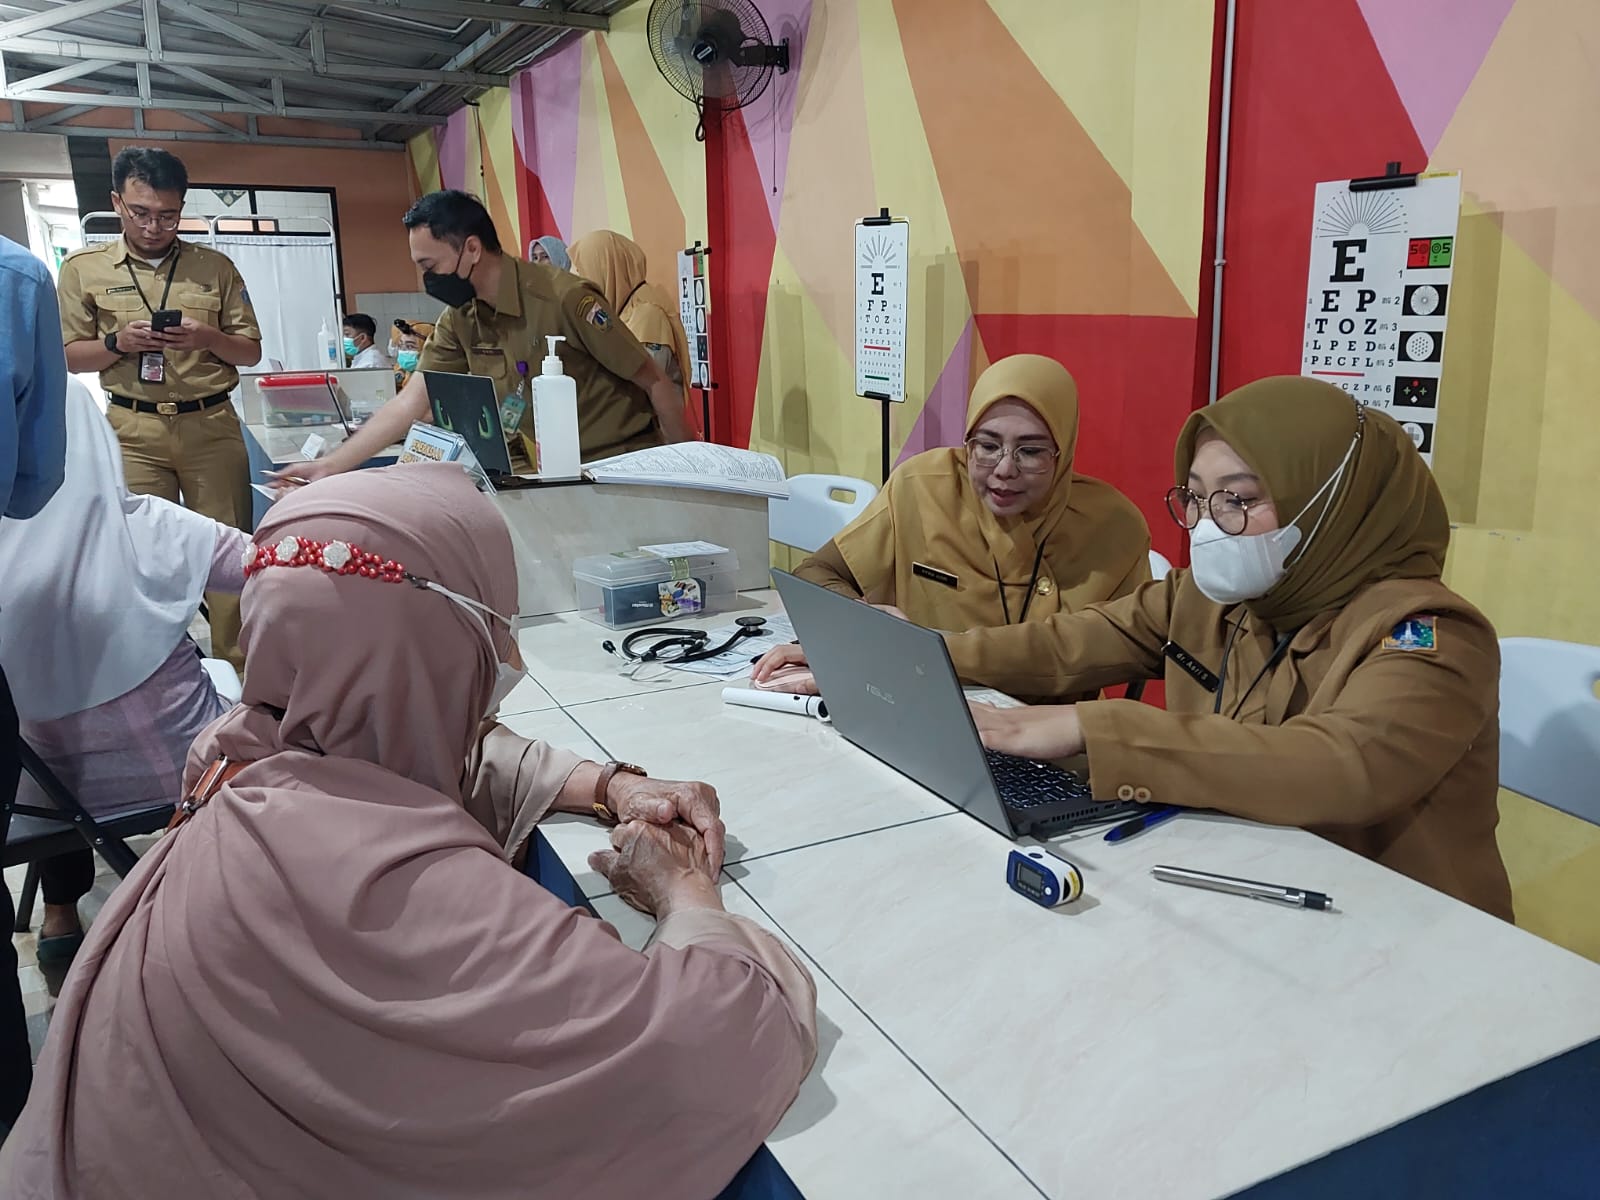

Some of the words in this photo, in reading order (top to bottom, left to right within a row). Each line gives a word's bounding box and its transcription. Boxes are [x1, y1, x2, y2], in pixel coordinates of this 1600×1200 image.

[1329, 238, 1367, 283] E
[1398, 269, 1403, 279] 1
[871, 272, 885, 295] E
[1321, 290, 1340, 312] E
[1356, 289, 1377, 313] P
[1394, 296, 1400, 305] 2
[881, 300, 888, 312] P
[1391, 323, 1398, 332] 3
[1389, 343, 1395, 351] 4
[1388, 359, 1394, 368] 5
[1385, 385, 1391, 393] 6
[1384, 400, 1390, 408] 7
